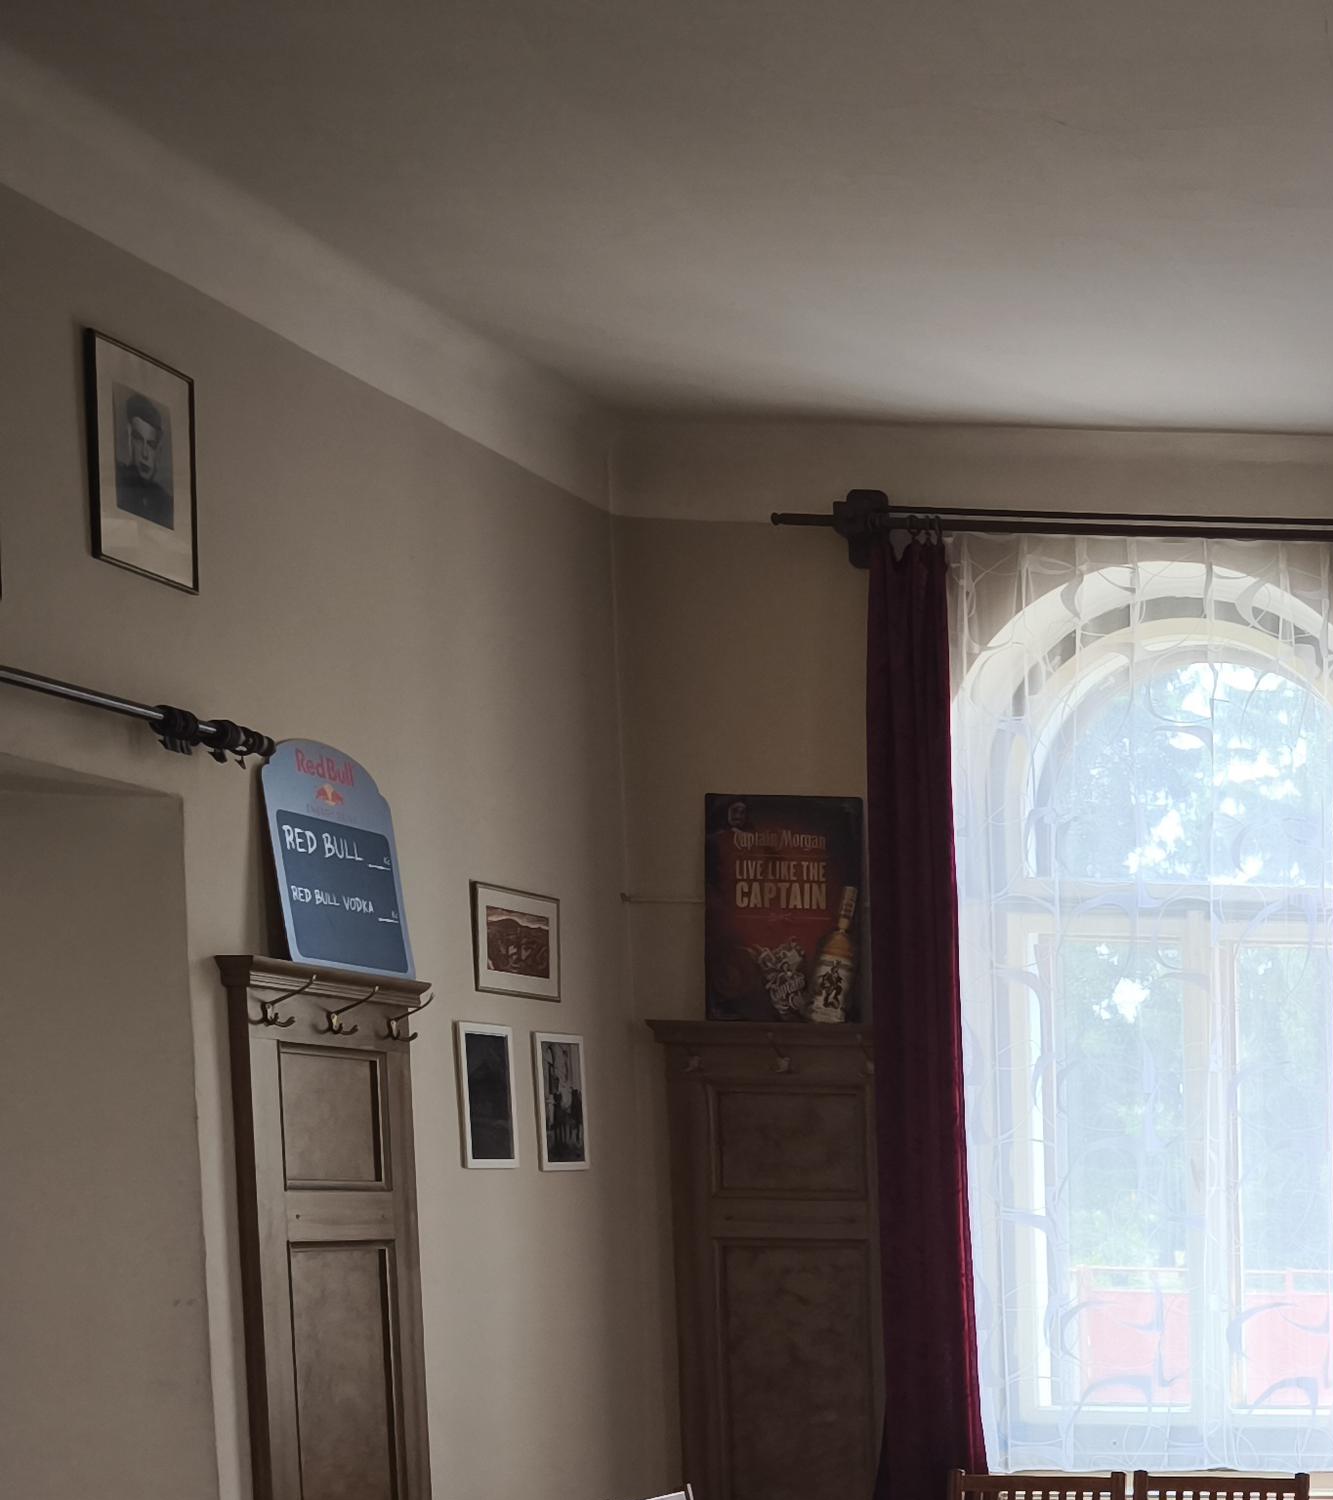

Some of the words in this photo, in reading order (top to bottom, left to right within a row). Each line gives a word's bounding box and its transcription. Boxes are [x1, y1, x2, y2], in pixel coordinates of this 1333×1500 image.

[294, 748, 325, 778] Red
[325, 756, 354, 787] Bull
[282, 825, 317, 855] RED
[322, 832, 364, 862] BULL
[777, 830, 826, 853] Morgan
[735, 860, 764, 880] LIVE
[768, 860, 798, 881] LIKE
[801, 861, 827, 882] THE
[290, 884, 312, 903] RED
[314, 889, 341, 906] BULL
[342, 895, 374, 913] VODKA
[735, 881, 827, 911] CAPTAIN
